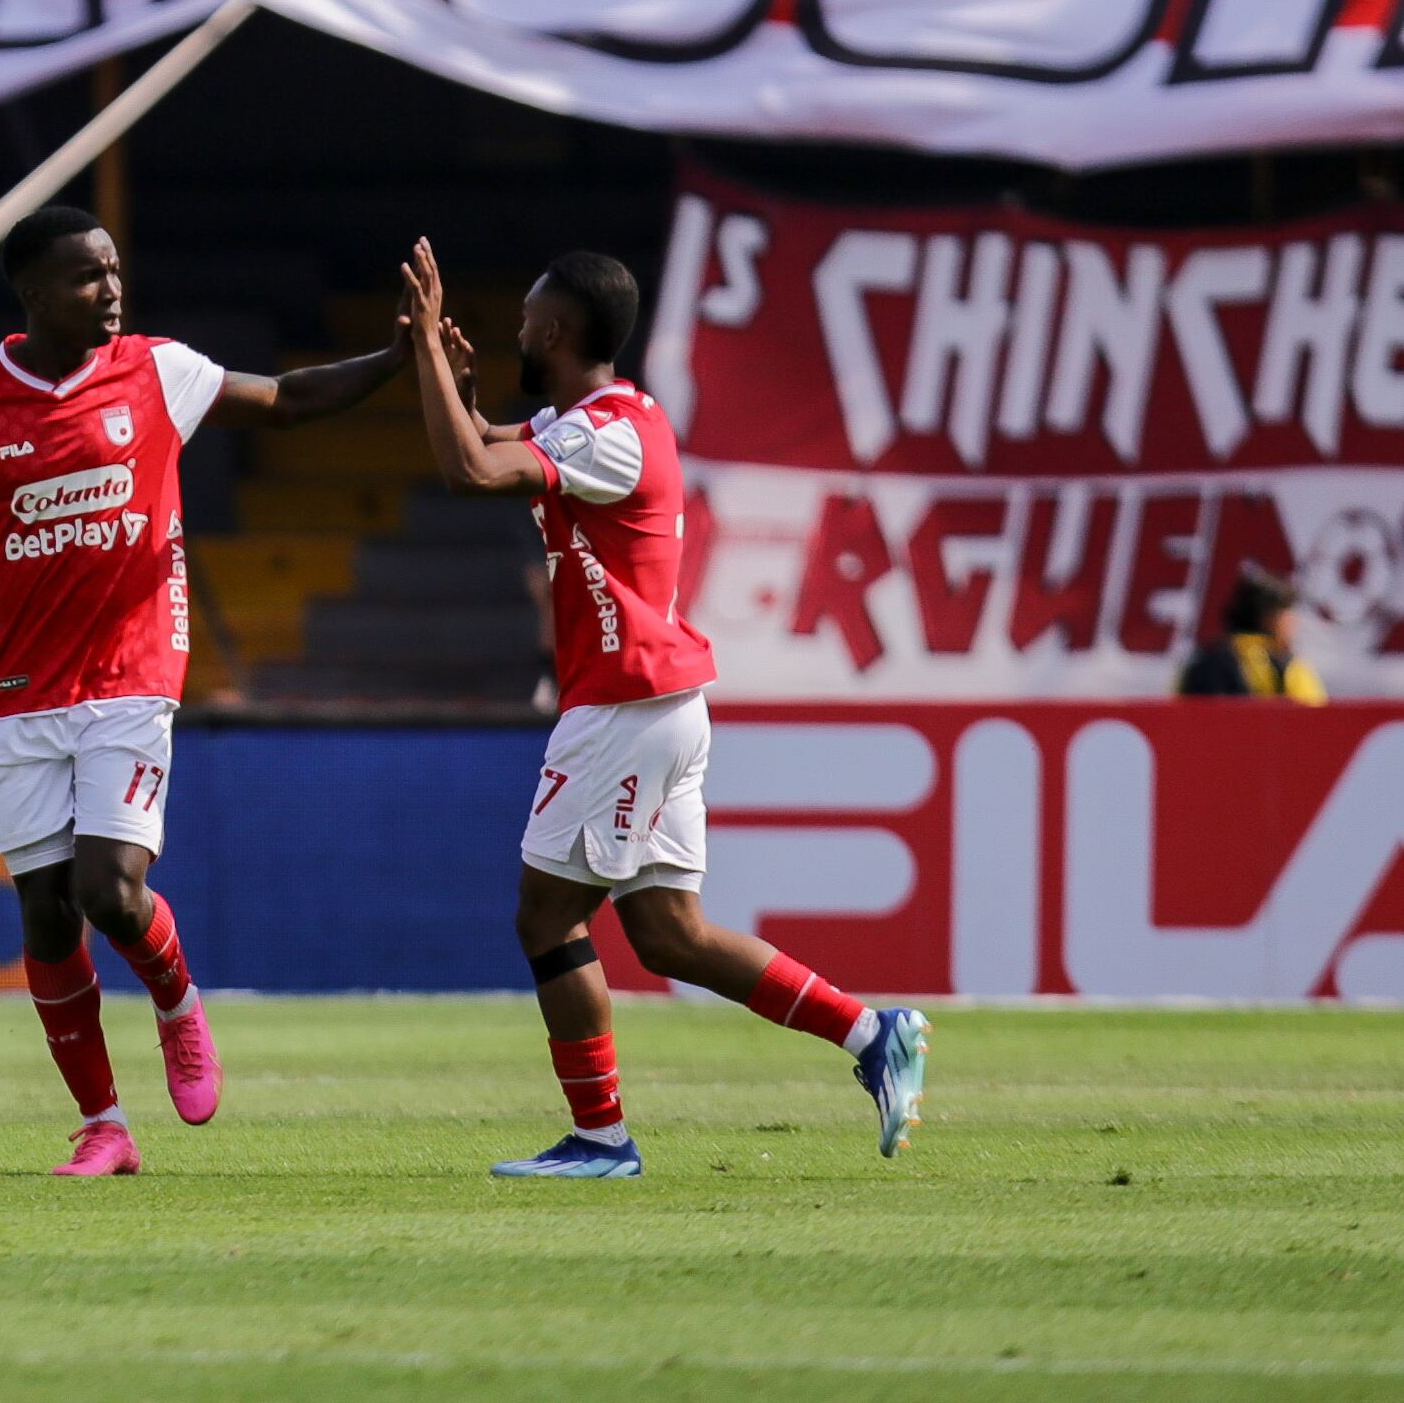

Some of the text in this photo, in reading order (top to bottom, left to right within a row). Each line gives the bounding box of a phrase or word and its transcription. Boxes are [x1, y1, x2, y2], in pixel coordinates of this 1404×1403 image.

[0, 440, 35, 460] FILA
[14, 476, 129, 515] Colanta
[4, 517, 119, 562] BetPlay
[166, 543, 190, 653] BetPlay
[122, 761, 164, 812] 17
[534, 768, 569, 817] 7
[614, 774, 639, 830] FILA
